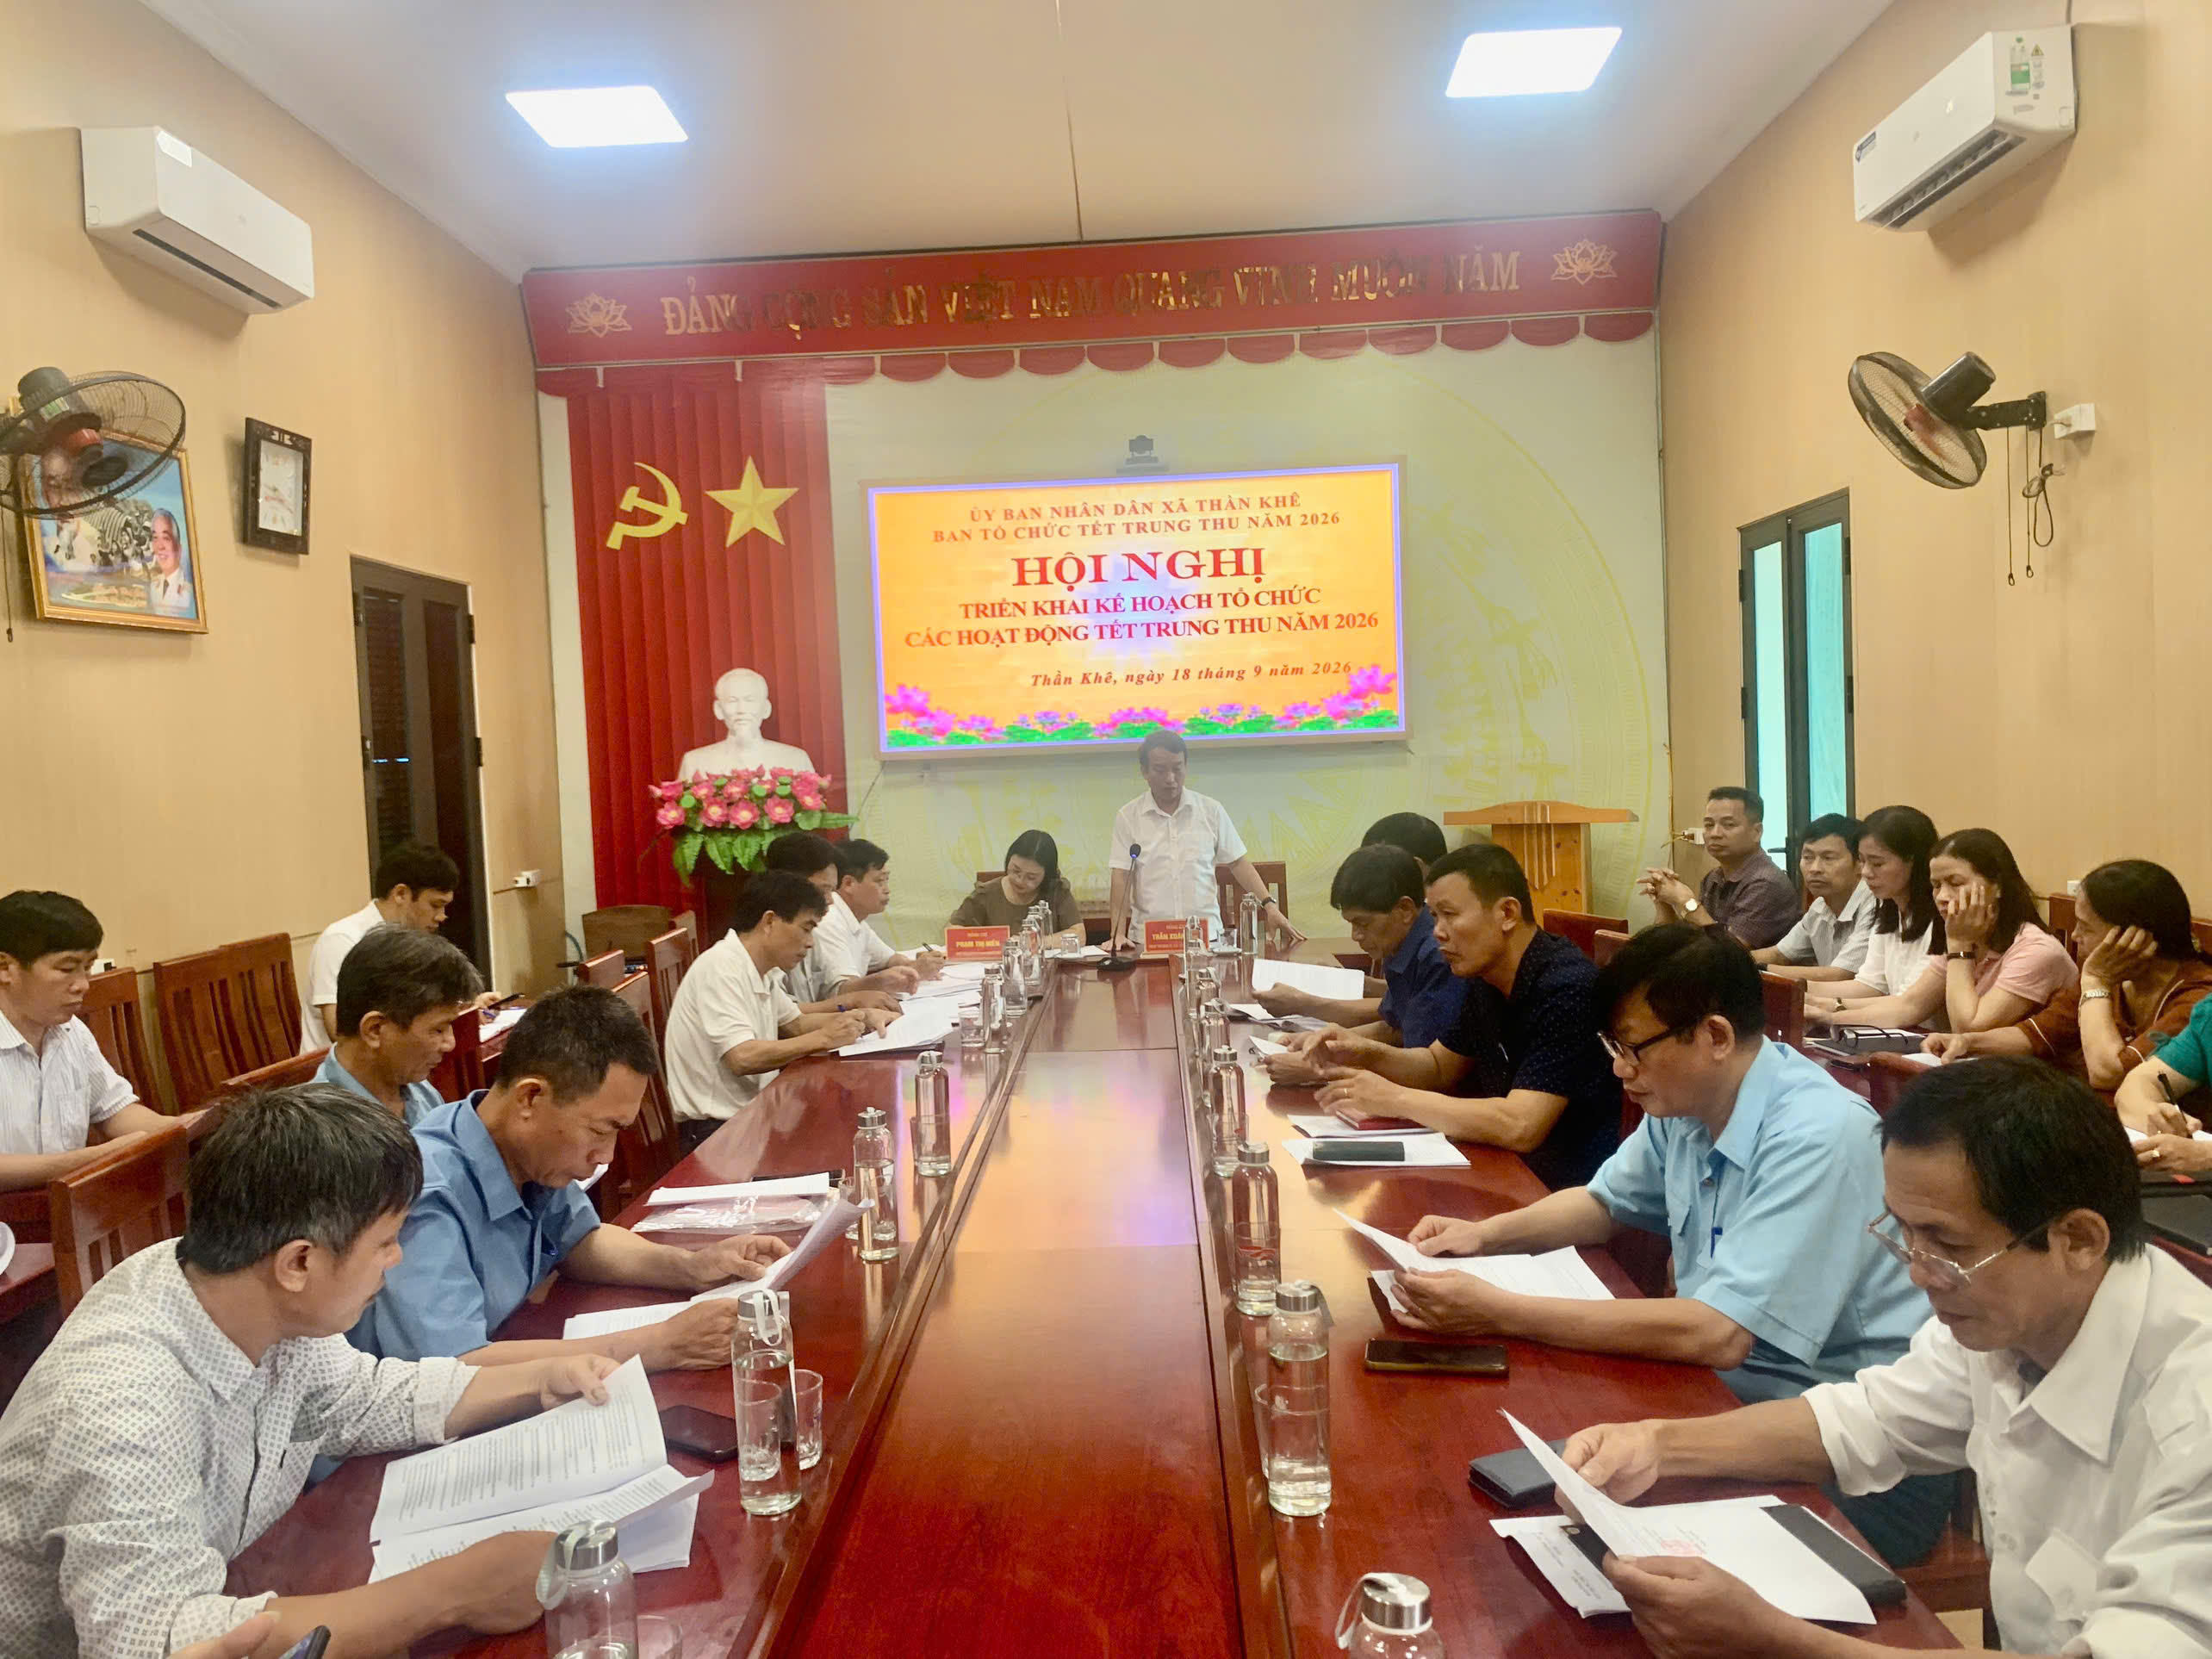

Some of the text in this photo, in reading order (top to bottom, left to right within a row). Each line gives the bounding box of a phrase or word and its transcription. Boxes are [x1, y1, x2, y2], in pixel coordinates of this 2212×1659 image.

[1443, 242, 1520, 294] NĂM
[970, 492, 1302, 522] ỦY BAN NHÂN DÂN XÃ THẦN KHÊ
[933, 529, 972, 543] BAN
[1013, 522, 1072, 539] CHỨC
[1077, 520, 1116, 537] TẾT
[1122, 519, 1191, 535] TRUNG
[1198, 517, 1240, 531] THU
[1247, 513, 1292, 529] NĂM
[1300, 512, 1340, 526] 2026
[1010, 547, 1266, 593] HỘI NGHỊ
[958, 584, 1321, 619] TRIỂN KHAI KẾ HOẠCH TỔ CHỨC
[904, 612, 1379, 648] CÁC HOẠT ĐỘNG TẾT TRUNG THU NĂM 2026
[1031, 661, 1351, 687] Thần Khê, ngày 18 tháng 9 năm 2026
